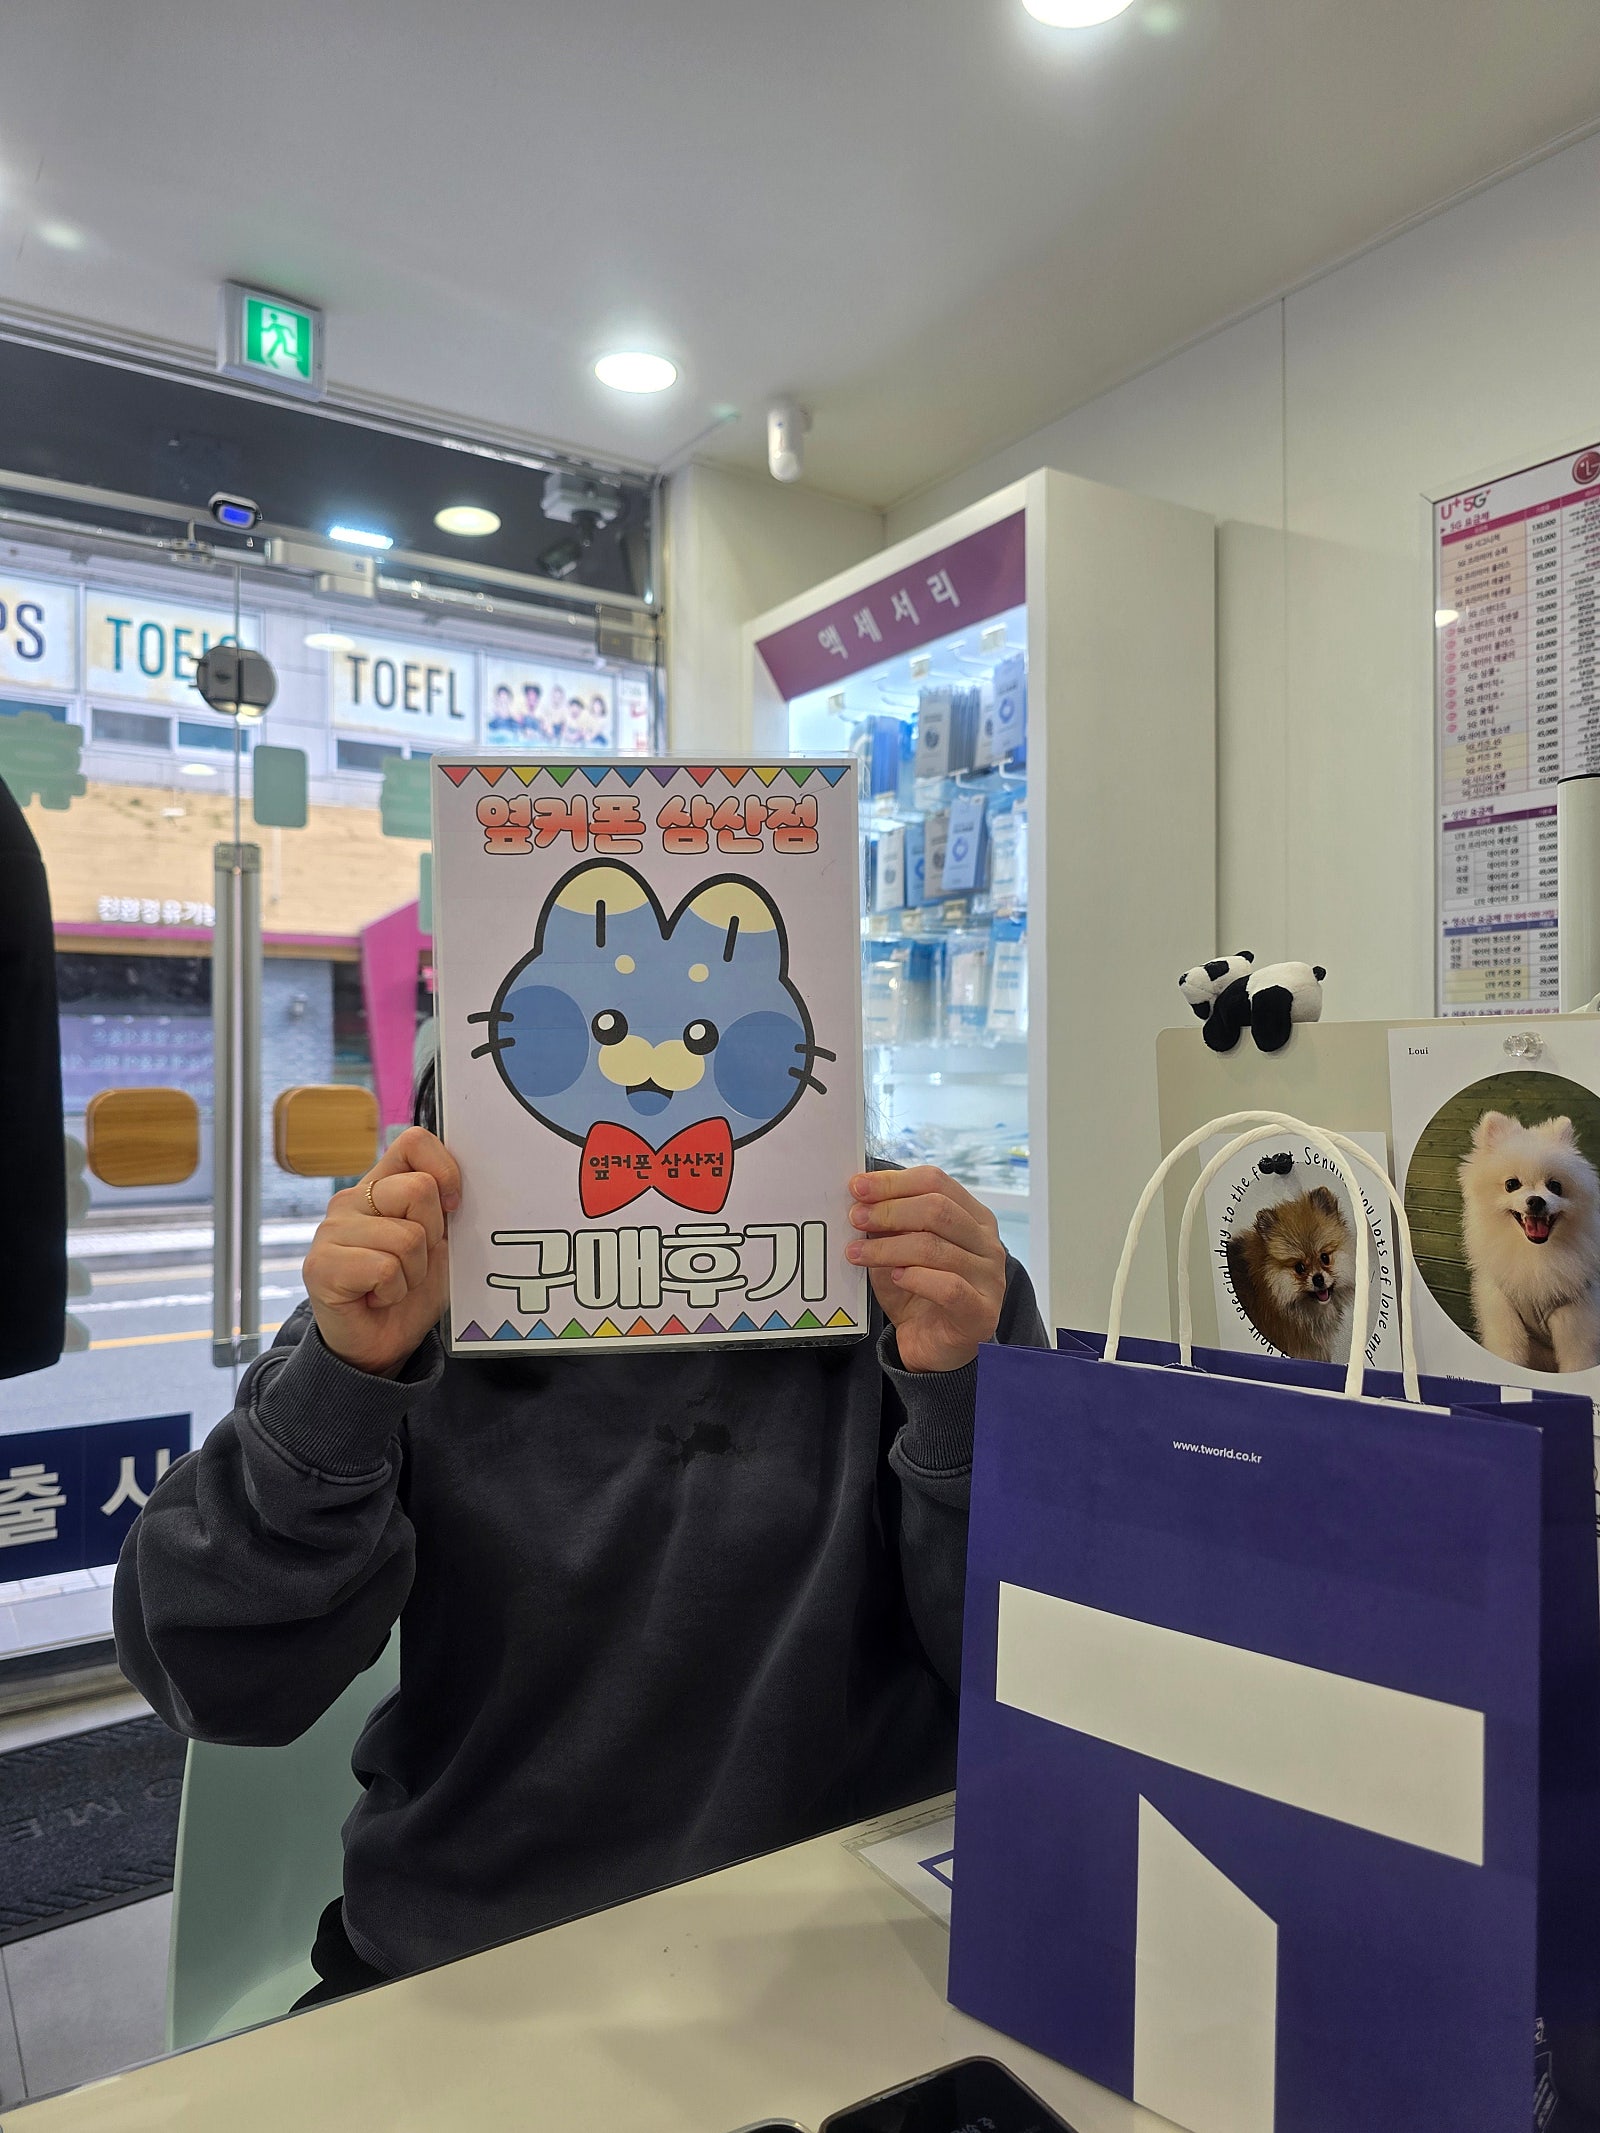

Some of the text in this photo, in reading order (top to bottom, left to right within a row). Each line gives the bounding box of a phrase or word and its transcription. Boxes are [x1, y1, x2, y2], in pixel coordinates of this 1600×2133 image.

[1463, 492, 1487, 512] 5G
[0, 602, 44, 660] S
[816, 568, 961, 660] 액세서리
[106, 616, 246, 681] TOE
[346, 655, 465, 719] TOEFL
[476, 794, 820, 855] 옆커폰 삼산점
[1408, 1046, 1429, 1056] Loui
[589, 1151, 726, 1181] 옆커폰 삼산점
[1231, 1177, 1250, 1202] the
[1222, 1206, 1235, 1224] to
[1213, 1229, 1232, 1257] day
[1371, 1219, 1388, 1257] lots
[486, 1220, 830, 1315] 구매후기
[1380, 1265, 1392, 1286] of
[1379, 1293, 1393, 1329] love
[1364, 1333, 1381, 1367] and
[1172, 1441, 1263, 1464] www.tworld.co.kr
